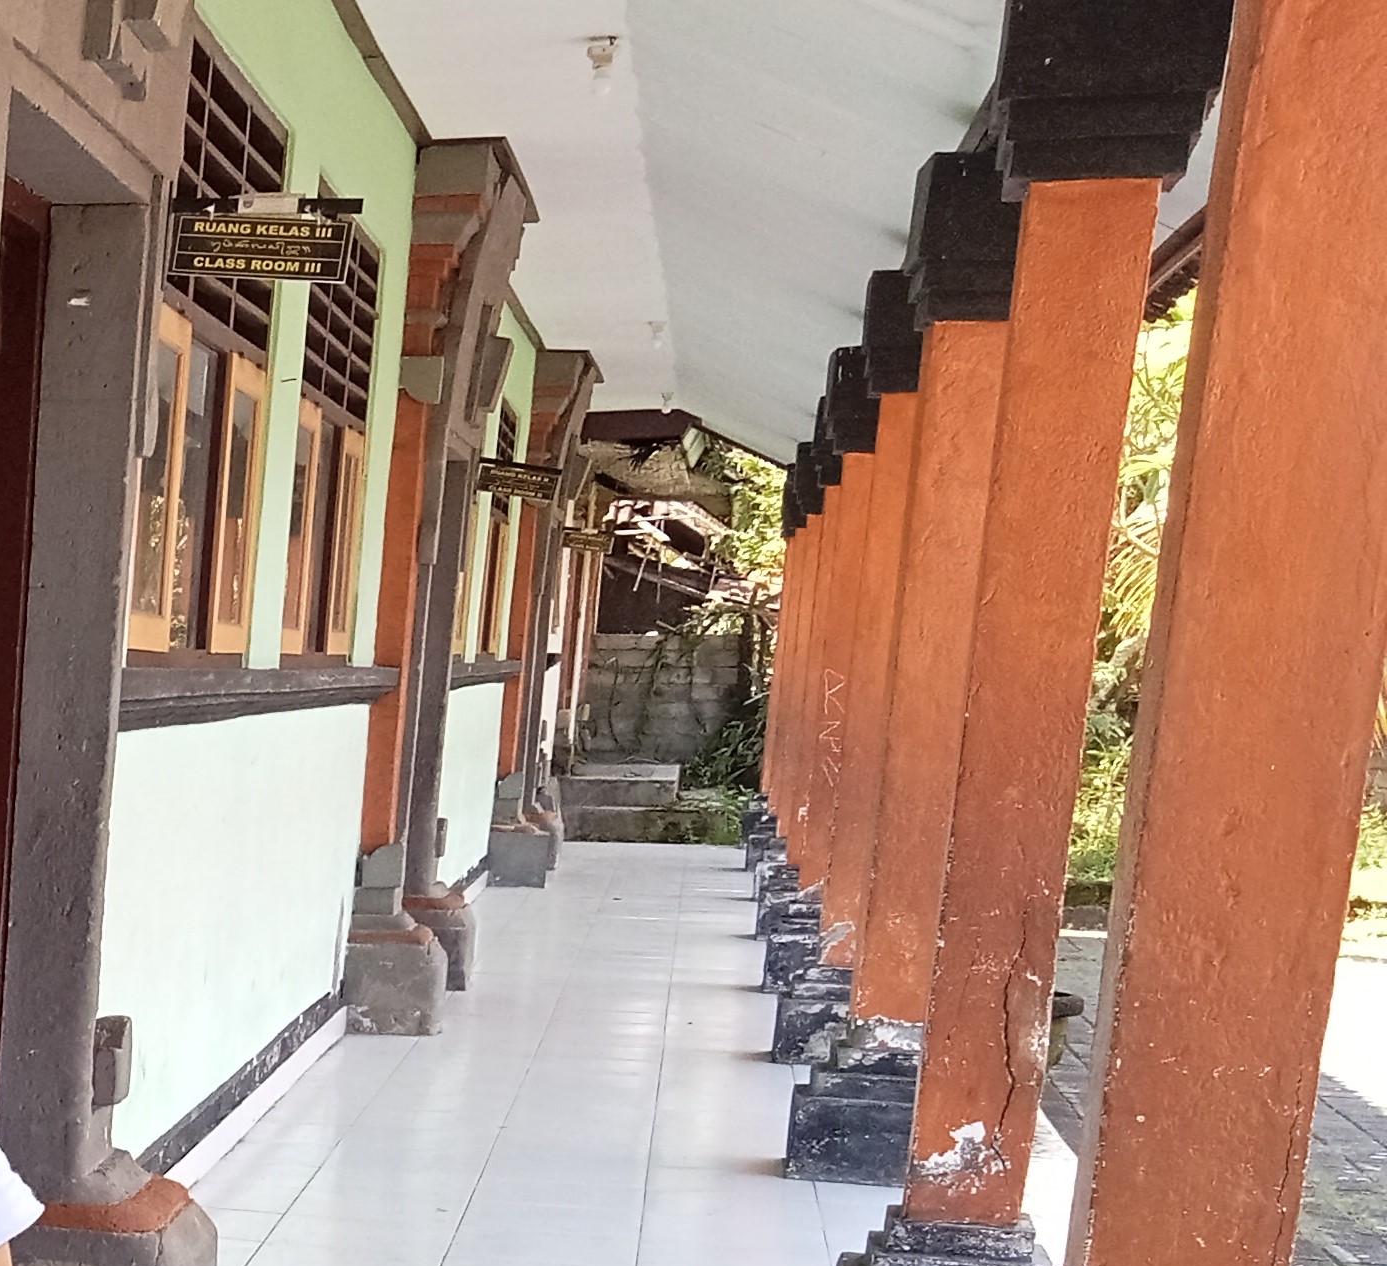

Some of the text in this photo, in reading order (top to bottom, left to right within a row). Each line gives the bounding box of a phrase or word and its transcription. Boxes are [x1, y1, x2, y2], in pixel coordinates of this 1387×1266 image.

[194, 221, 333, 238] RUANG KELAS III
[193, 257, 322, 273] CLASS ROOM III
